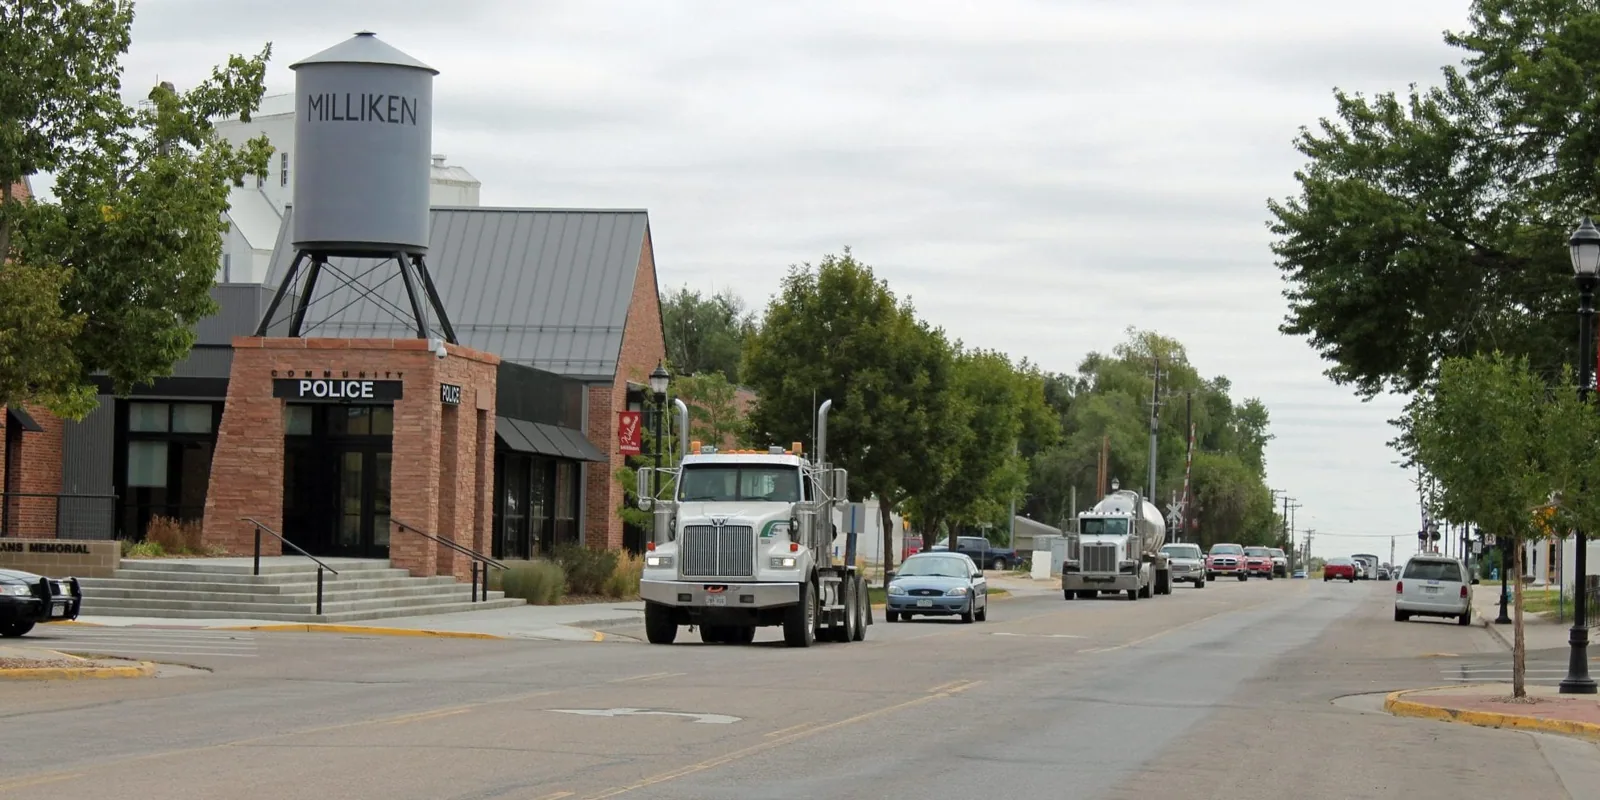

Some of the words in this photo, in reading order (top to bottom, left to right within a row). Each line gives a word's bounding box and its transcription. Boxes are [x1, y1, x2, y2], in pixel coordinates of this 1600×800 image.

[308, 93, 417, 126] MILLIKEN
[271, 369, 404, 379] COMMUNITY
[299, 380, 374, 398] POLICE
[442, 384, 460, 404] POLICE
[29, 543, 91, 554] MEMORIAL
